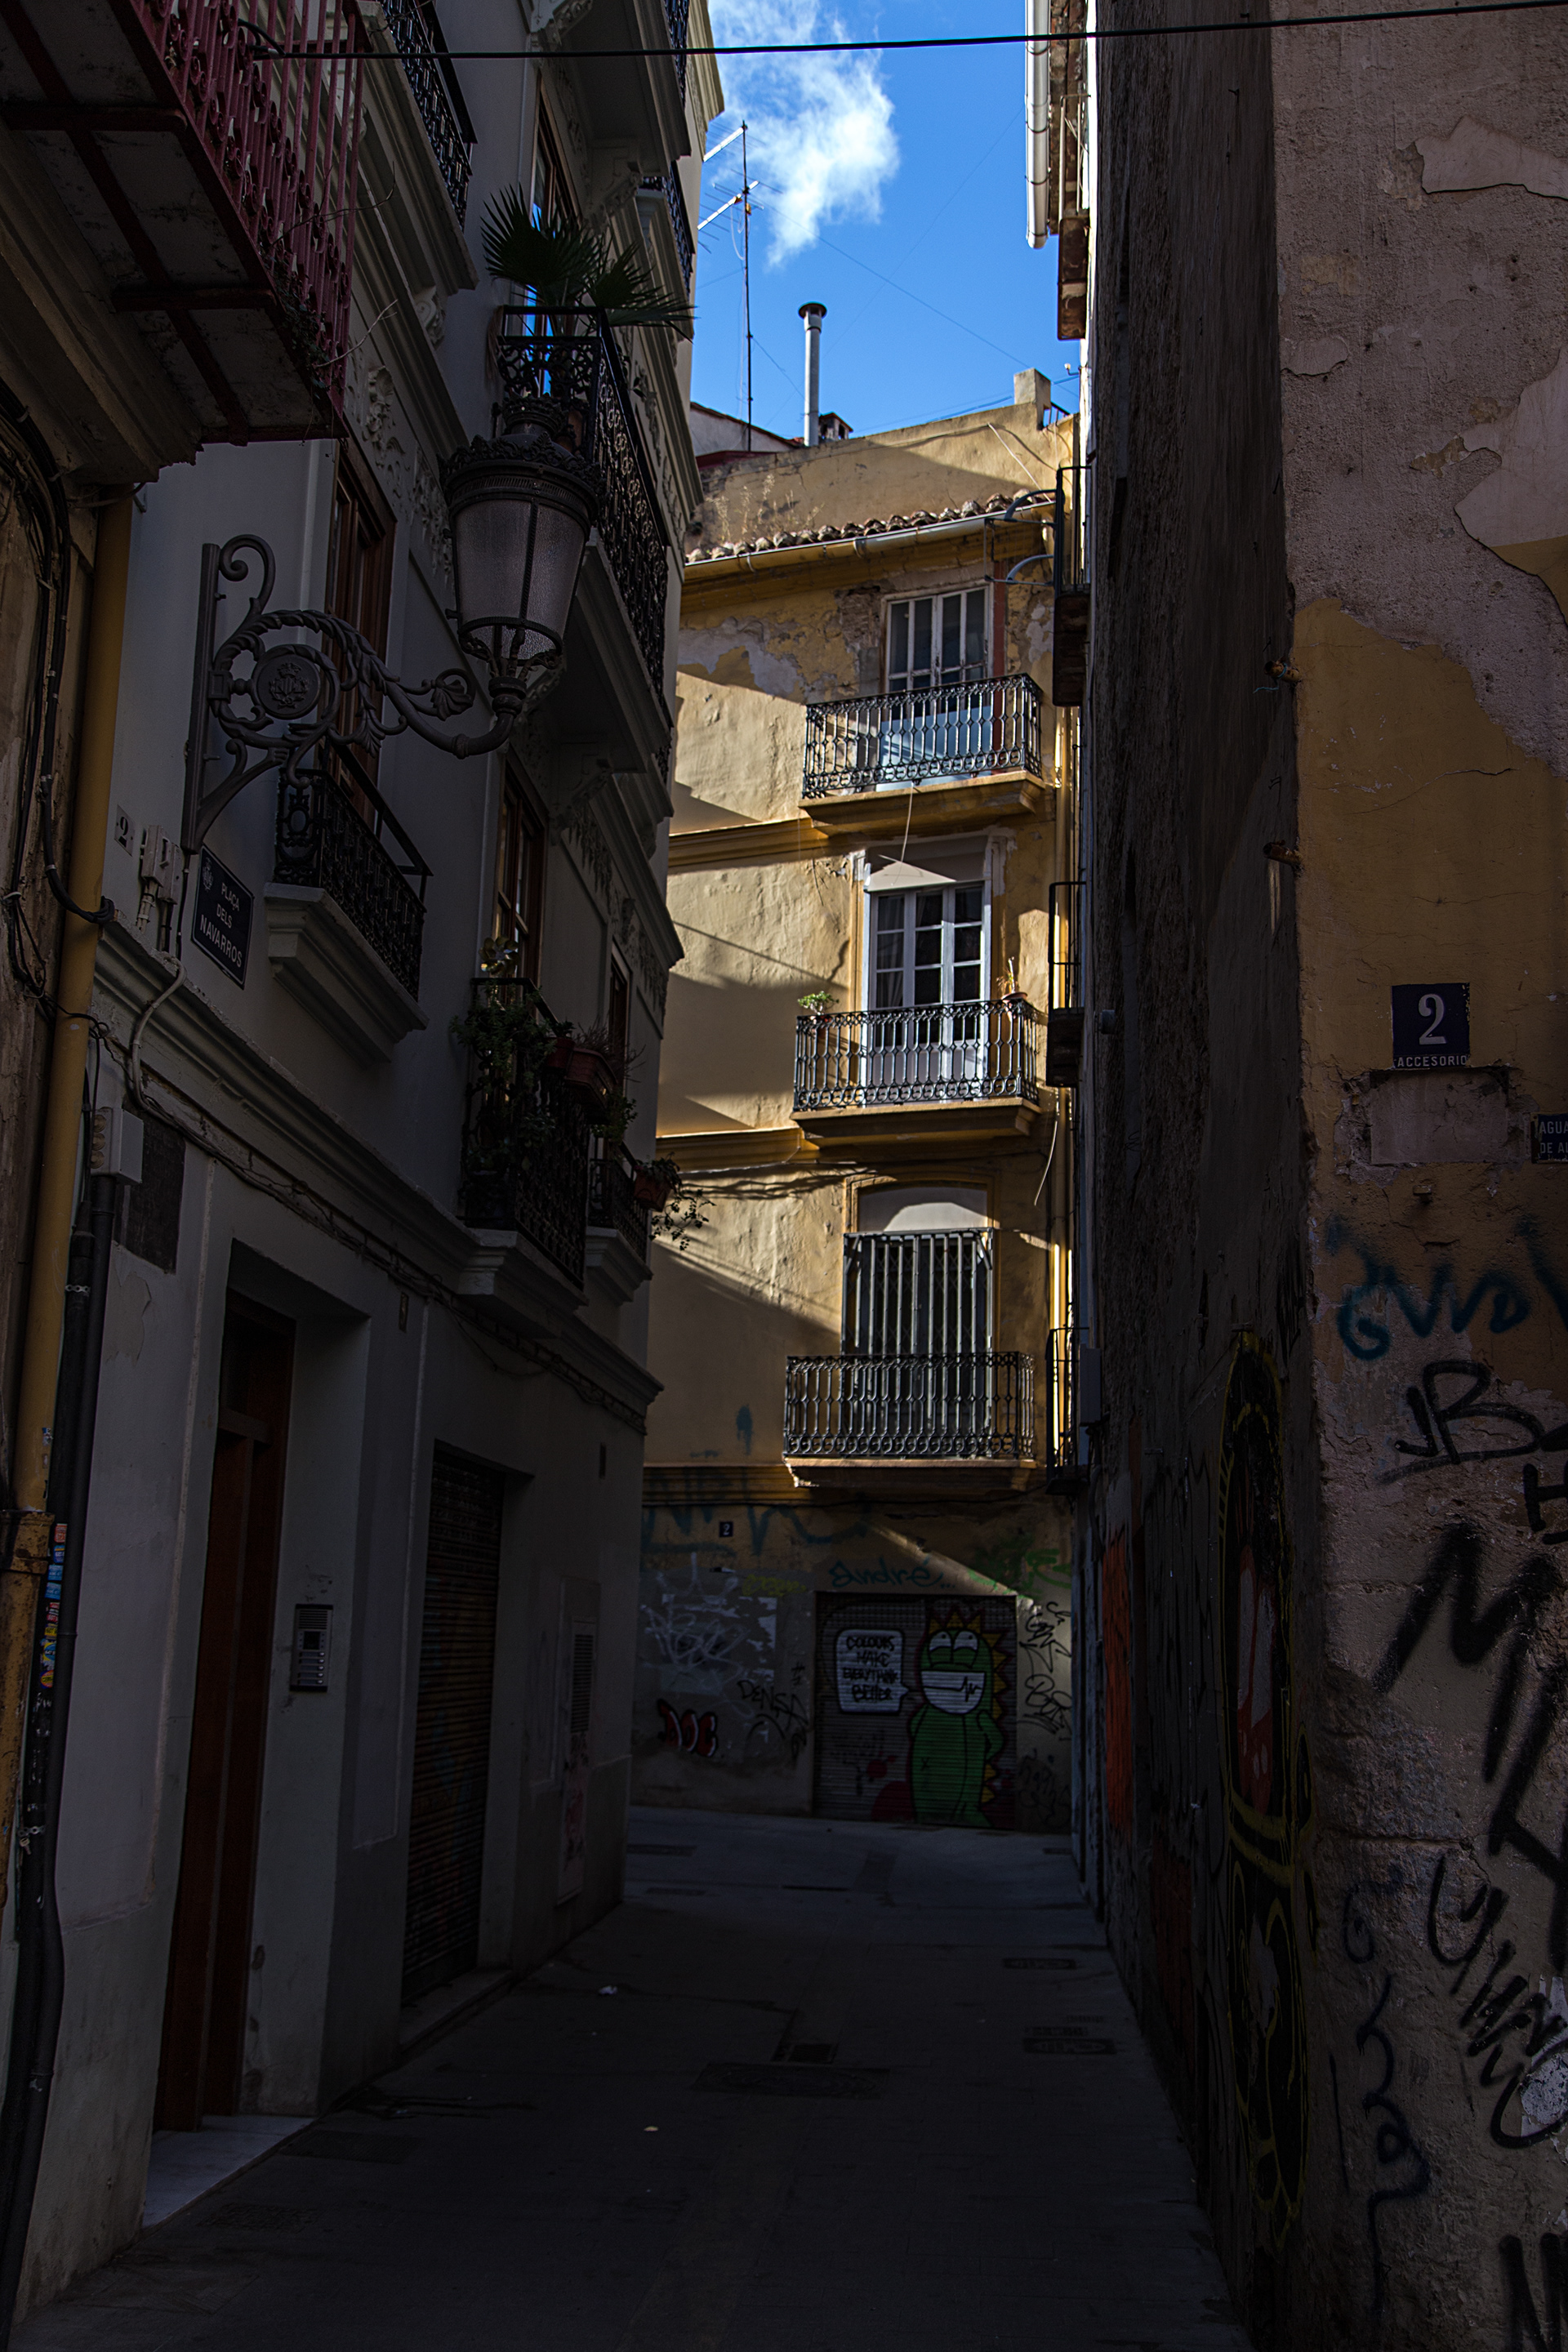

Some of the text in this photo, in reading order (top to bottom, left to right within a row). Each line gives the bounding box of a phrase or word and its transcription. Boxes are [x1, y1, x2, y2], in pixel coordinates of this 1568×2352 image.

[221, 882, 240, 911] PLAÇA
[216, 903, 233, 929] DELS
[200, 914, 243, 968] NAVARROS
[1417, 992, 1448, 1046] 2
[1397, 1055, 1467, 1068] ACCESORIO
[1539, 1142, 1553, 1154] DE
[722, 1523, 731, 1536] 2
